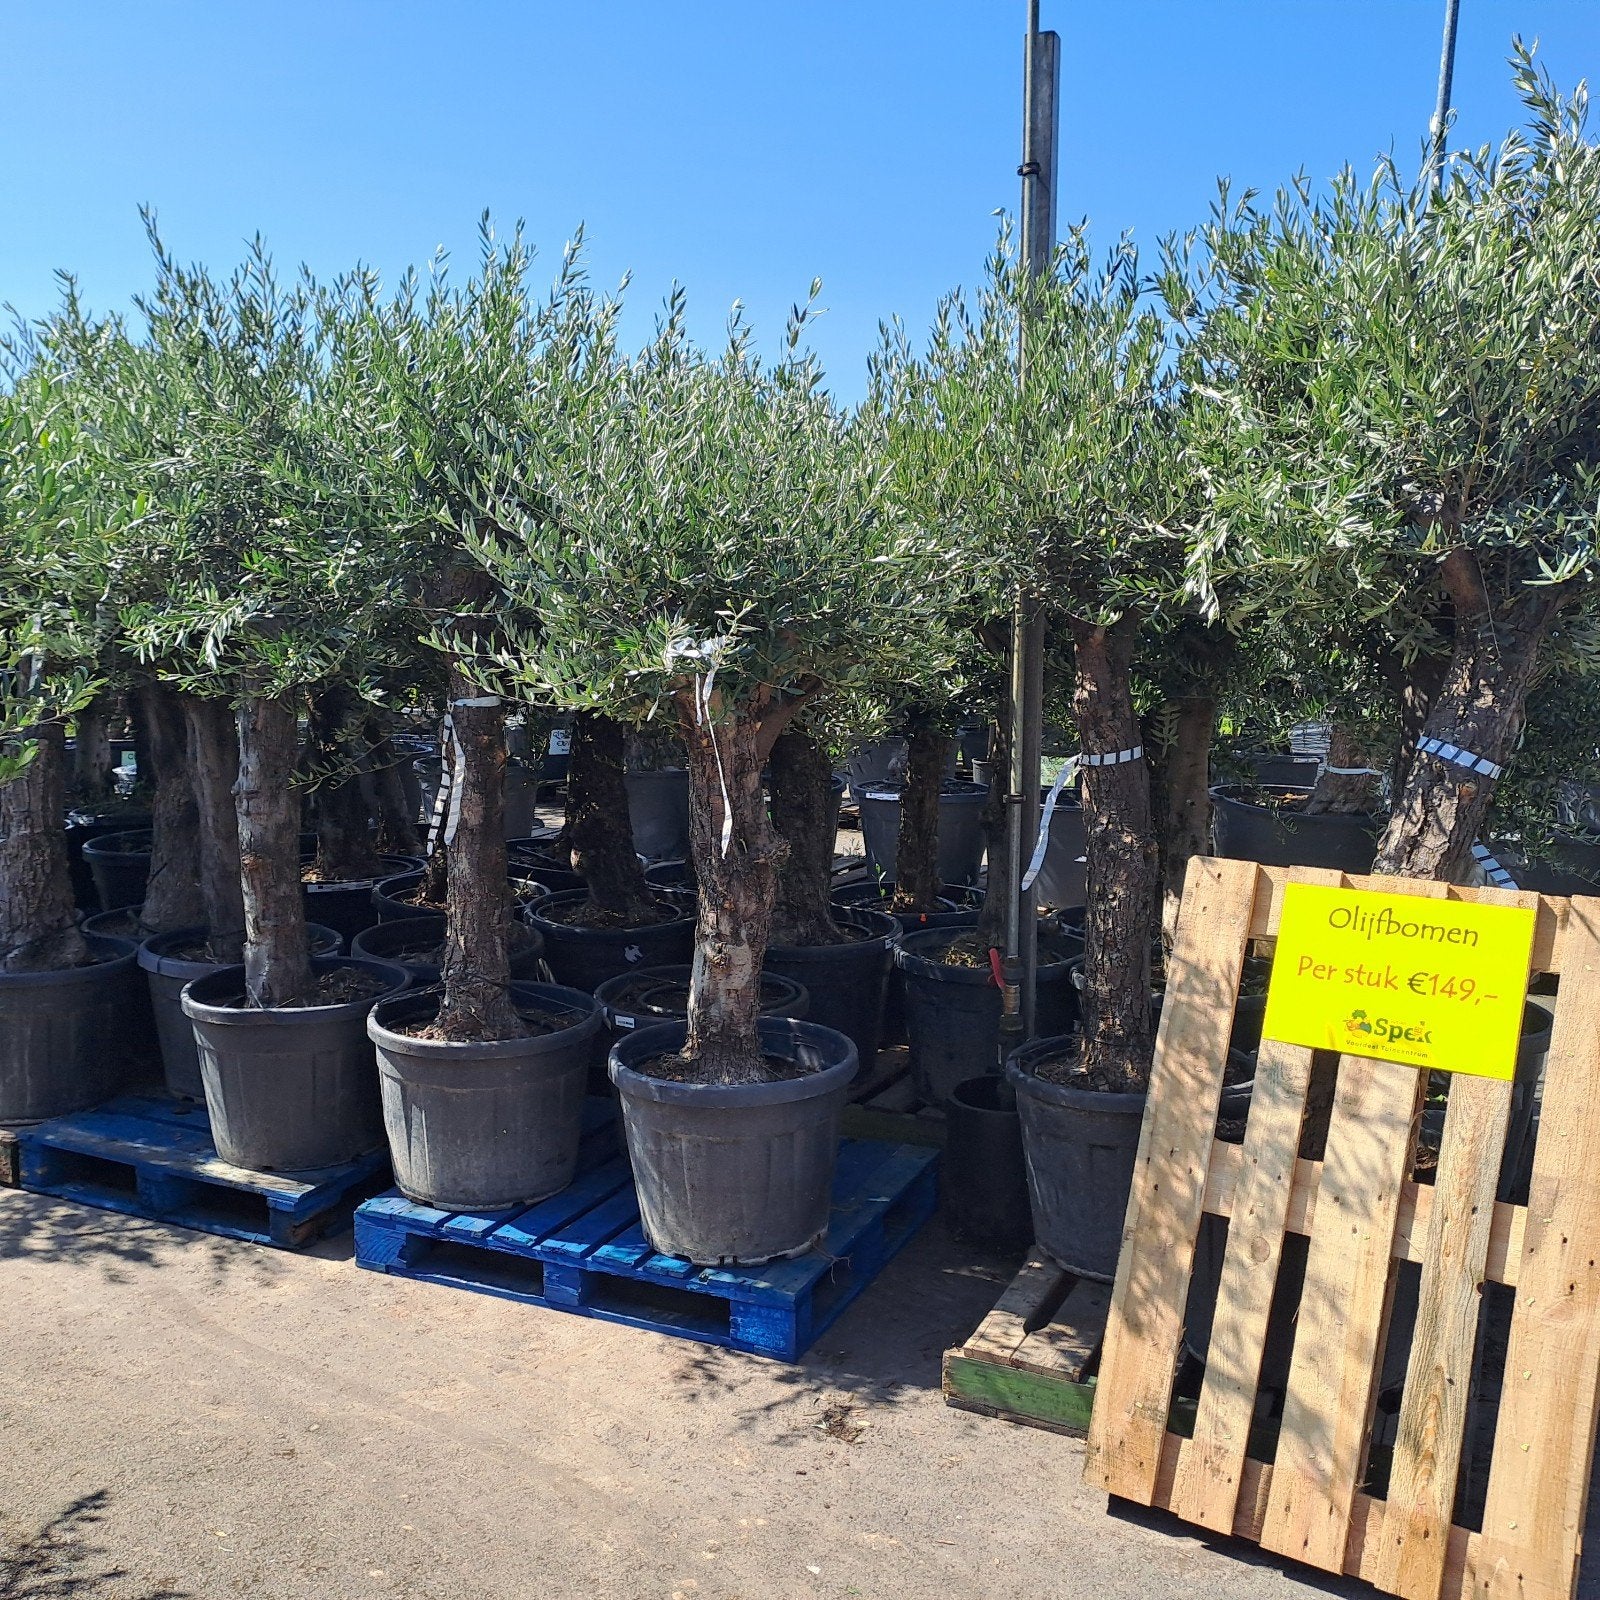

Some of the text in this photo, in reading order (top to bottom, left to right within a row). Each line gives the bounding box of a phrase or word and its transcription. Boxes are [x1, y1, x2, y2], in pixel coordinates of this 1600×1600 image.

[1328, 905, 1479, 947] Olijfbomen
[1297, 955, 1338, 981] Per
[1343, 963, 1399, 991] stuk
[1373, 1017, 1432, 1044] Spek
[1345, 1039, 1428, 1058] Voordeel Tuincentrum
